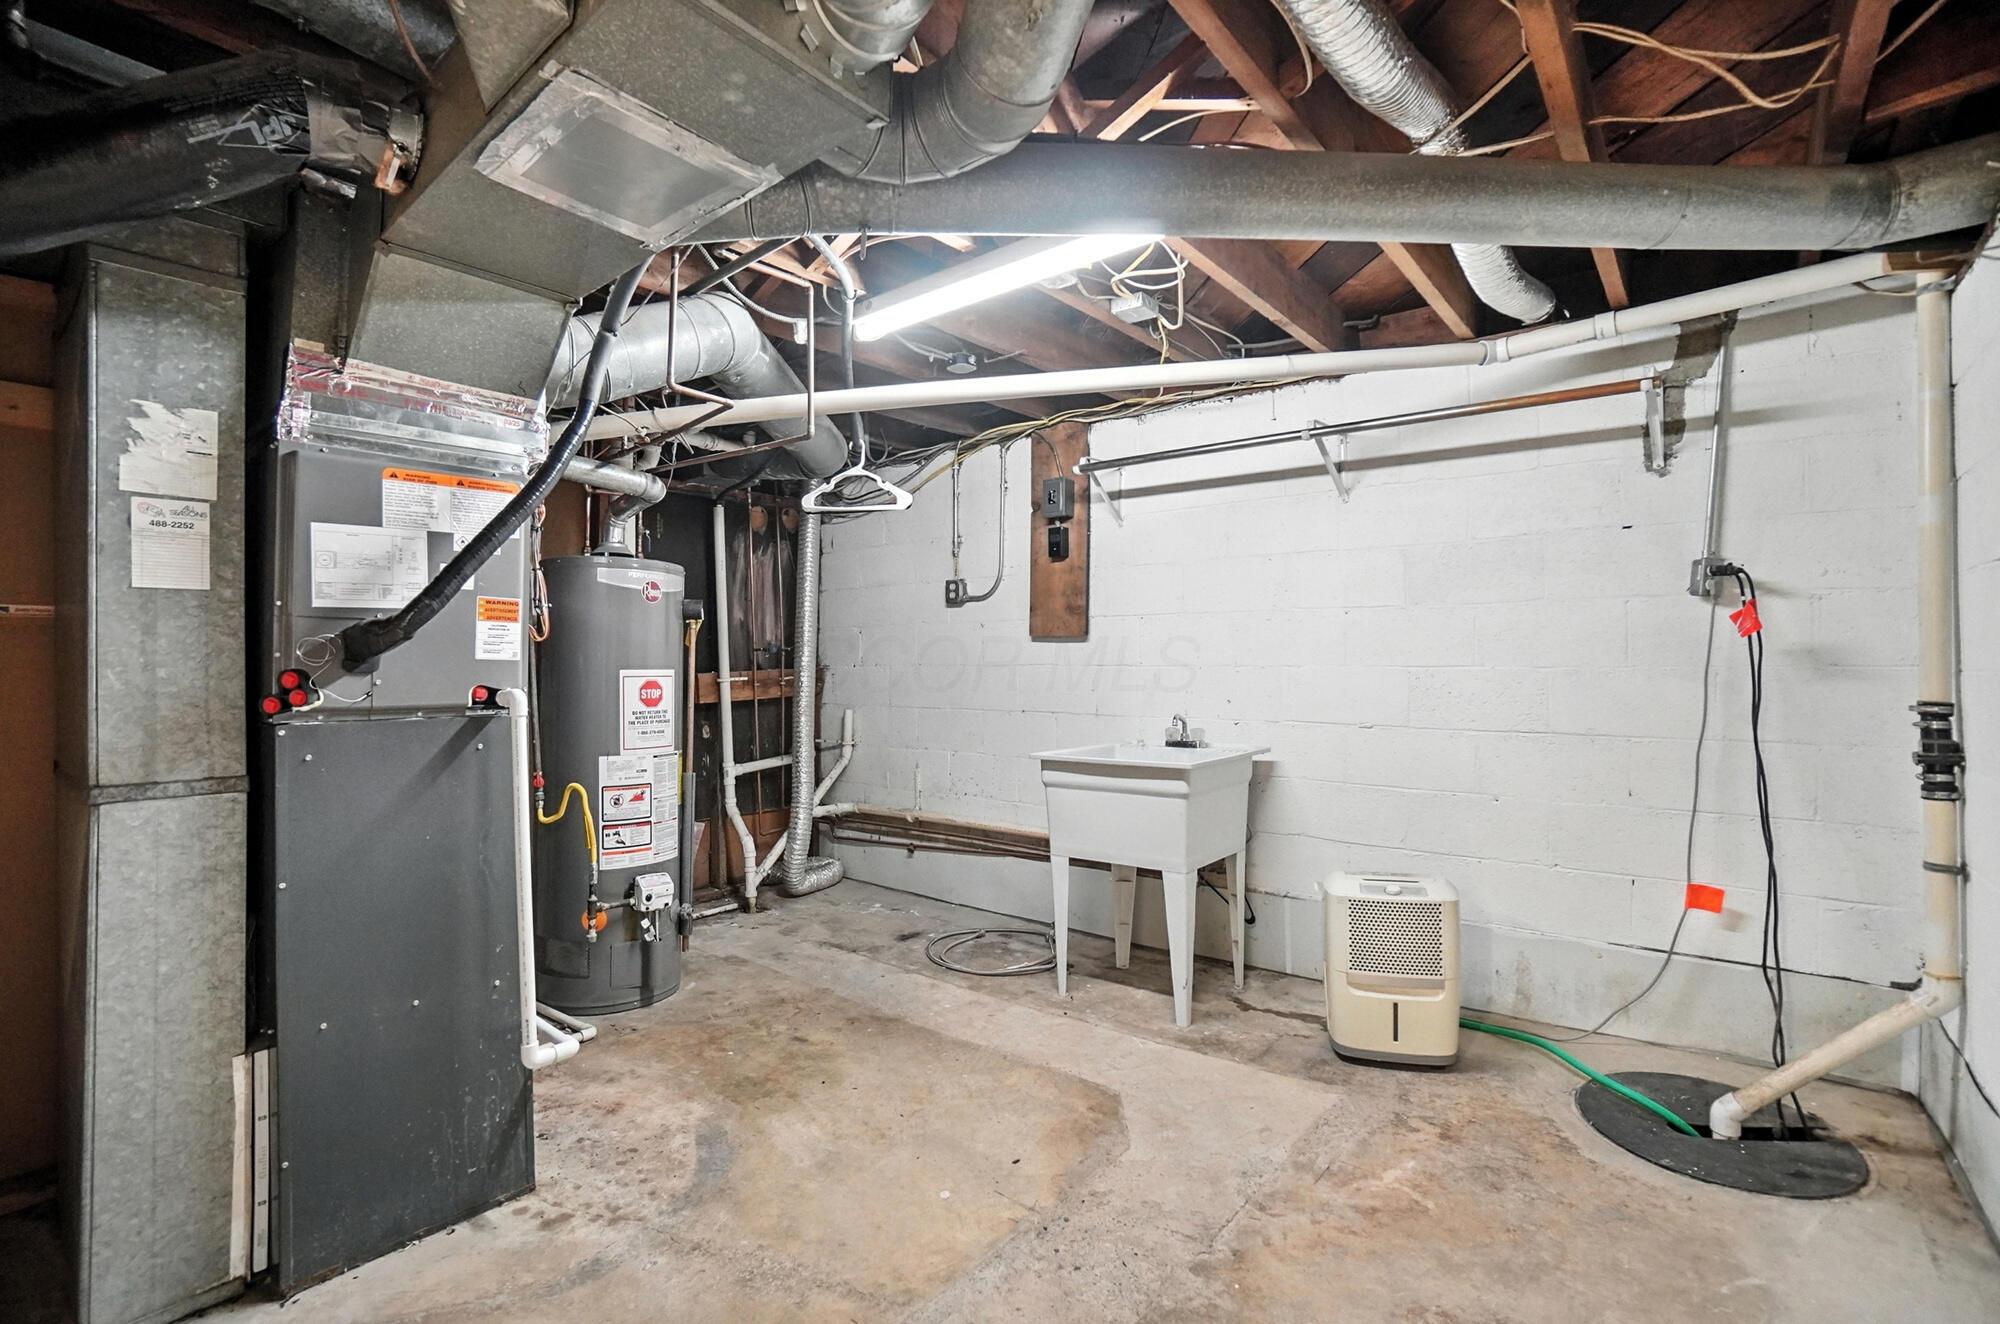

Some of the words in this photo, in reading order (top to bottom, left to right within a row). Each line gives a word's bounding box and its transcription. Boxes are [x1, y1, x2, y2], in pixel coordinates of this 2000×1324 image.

[149, 519, 195, 530] 488-2252
[485, 599, 520, 608] WARNING
[640, 688, 662, 699] STOP
